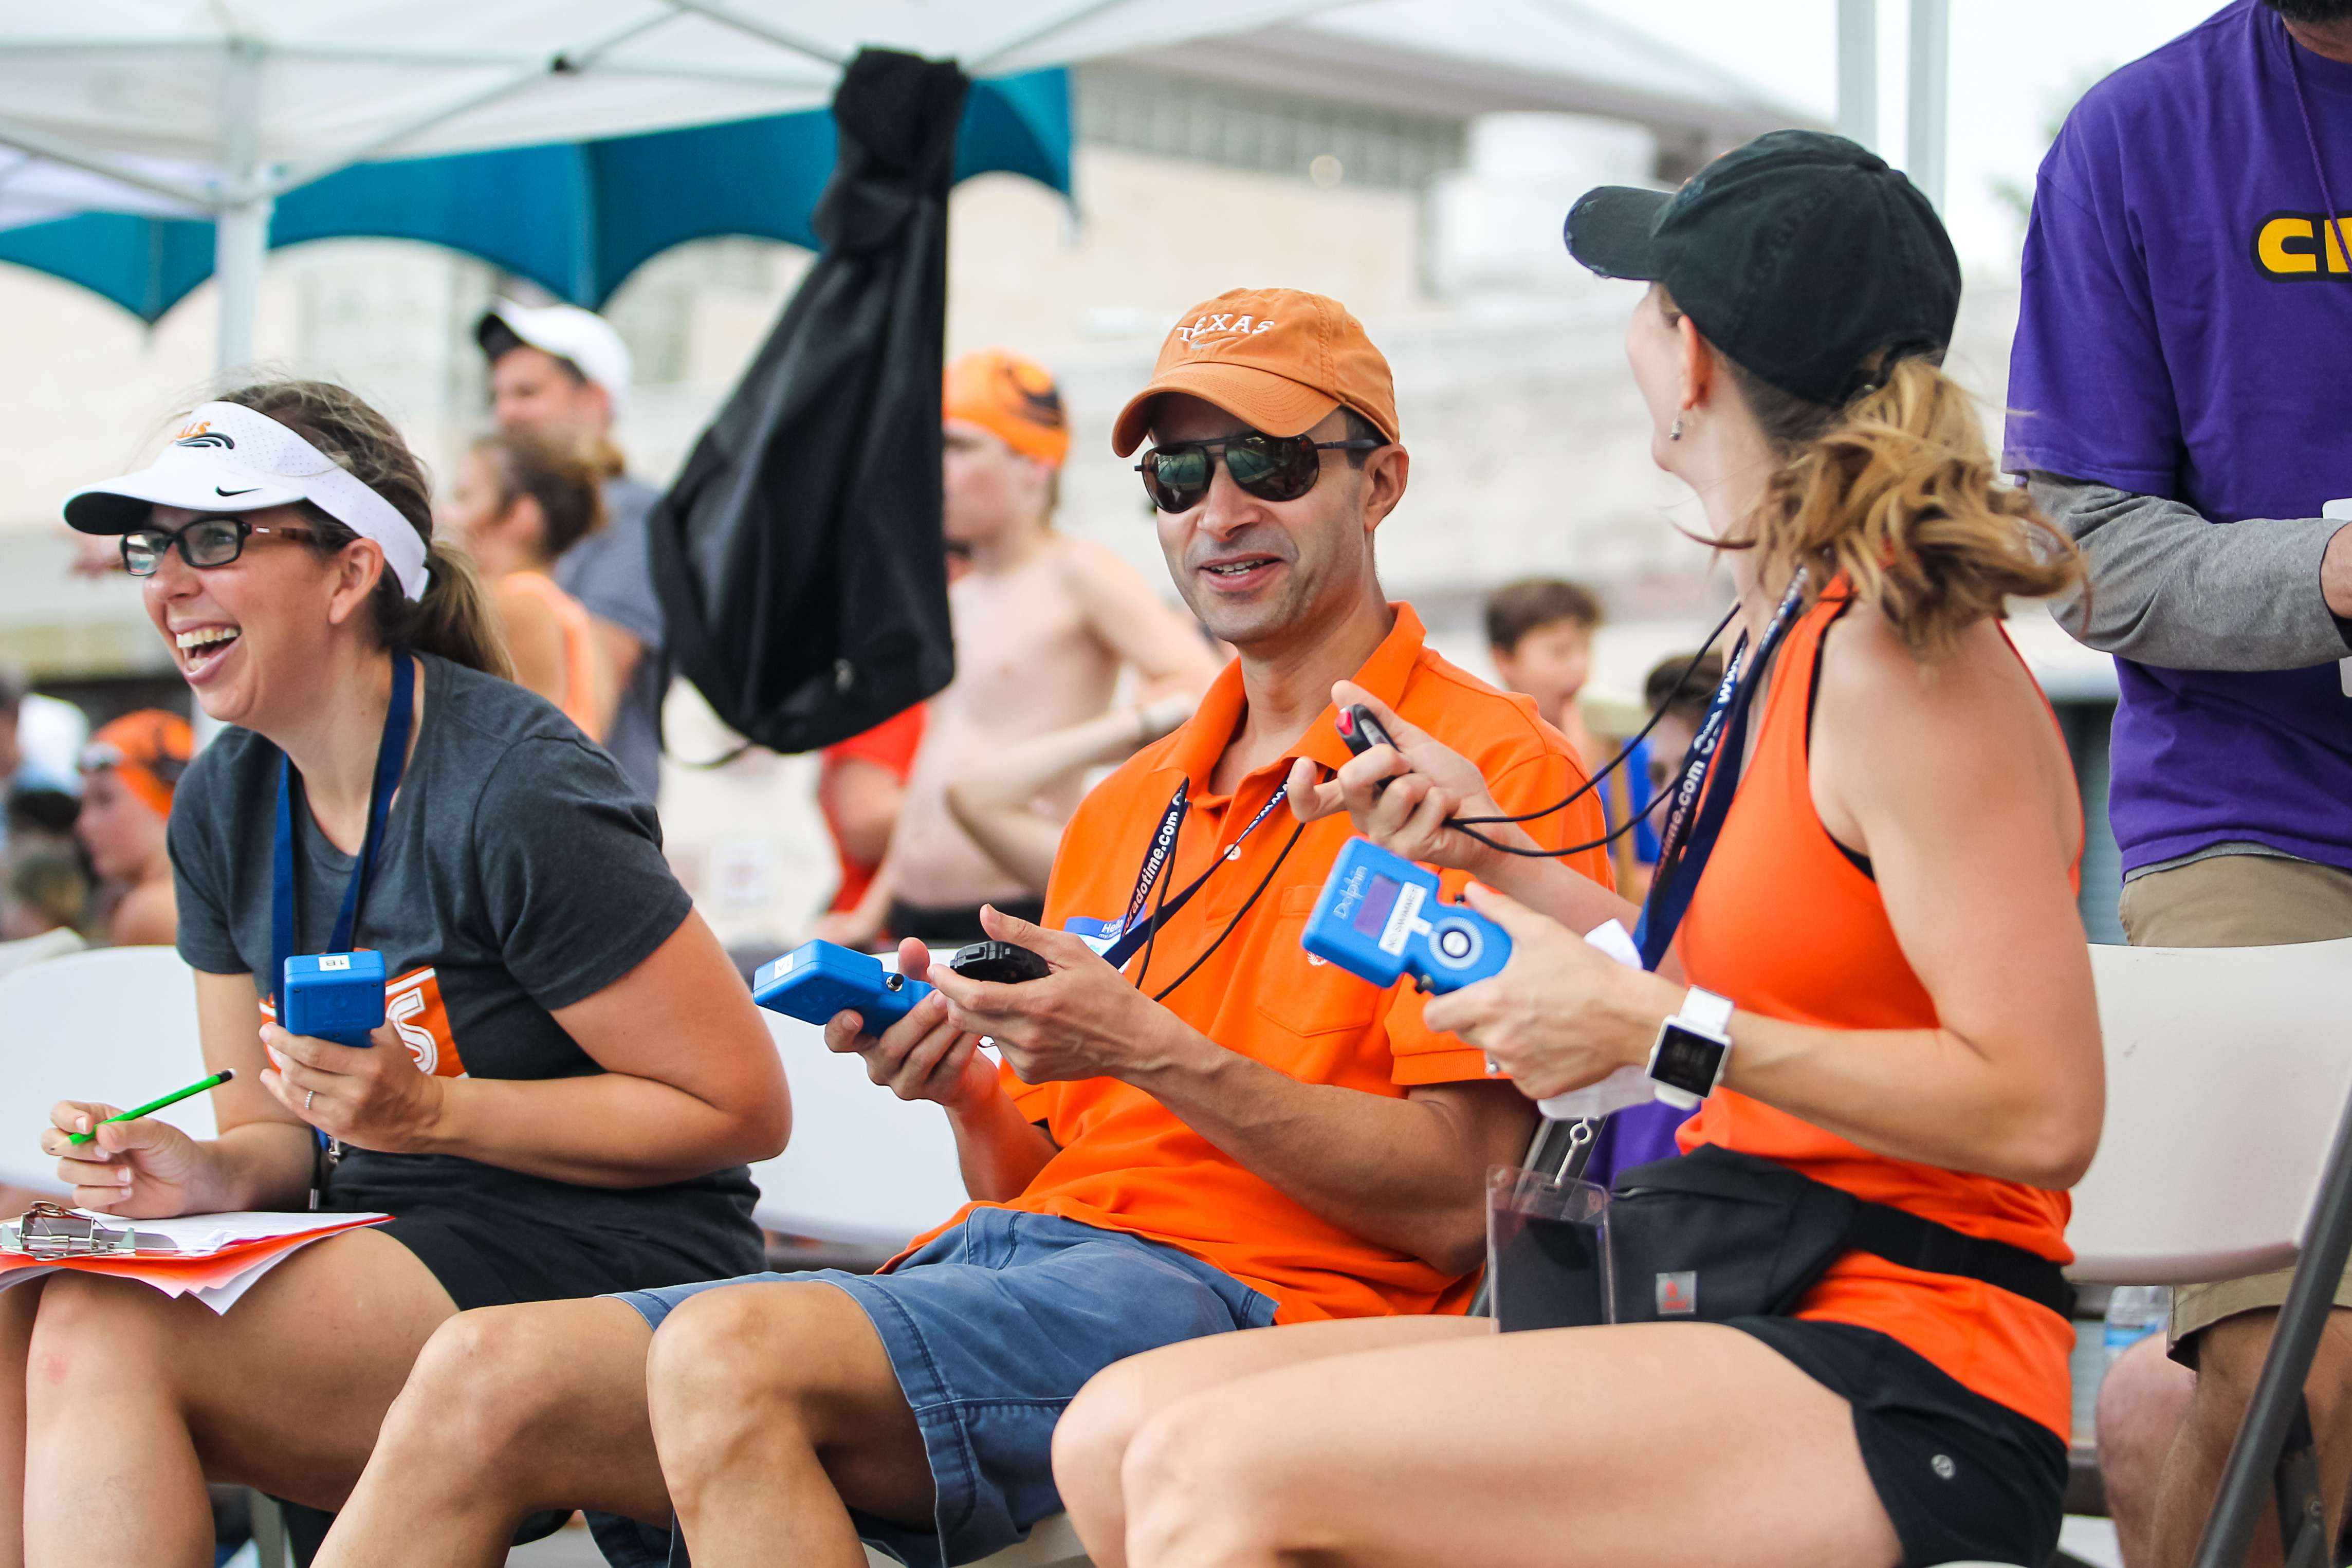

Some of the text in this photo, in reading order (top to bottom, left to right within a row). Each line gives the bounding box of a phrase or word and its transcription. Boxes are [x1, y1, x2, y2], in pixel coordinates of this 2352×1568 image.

[1177, 313, 1275, 342] TEXAS
[1333, 865, 1368, 920] Dolphin
[1101, 919, 1123, 933] Hello
